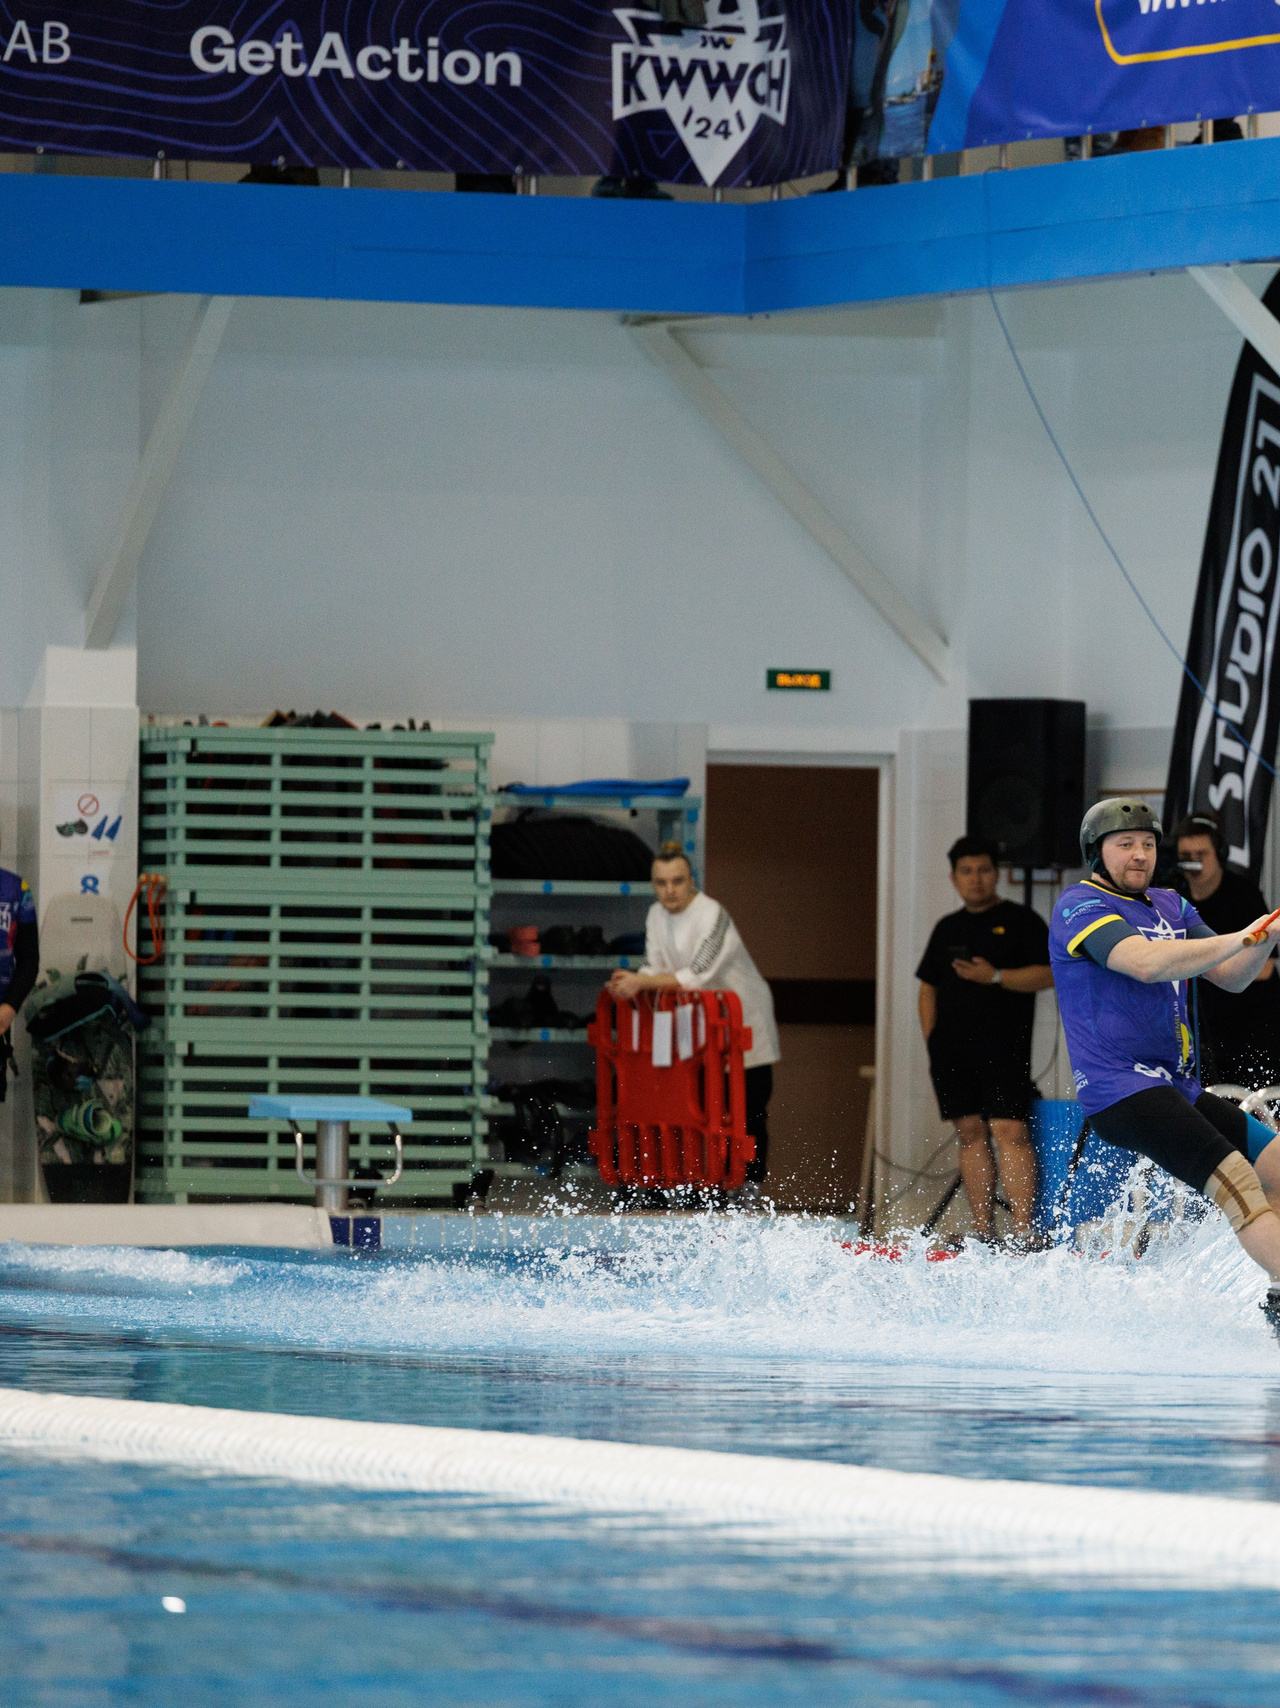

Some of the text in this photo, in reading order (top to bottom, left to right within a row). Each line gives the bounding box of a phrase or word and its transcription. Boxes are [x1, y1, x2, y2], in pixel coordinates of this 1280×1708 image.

[190, 25, 522, 86] GetAction
[622, 51, 787, 114] KWWCH
[695, 118, 732, 140] 24
[1209, 527, 1272, 810] STUDIO
